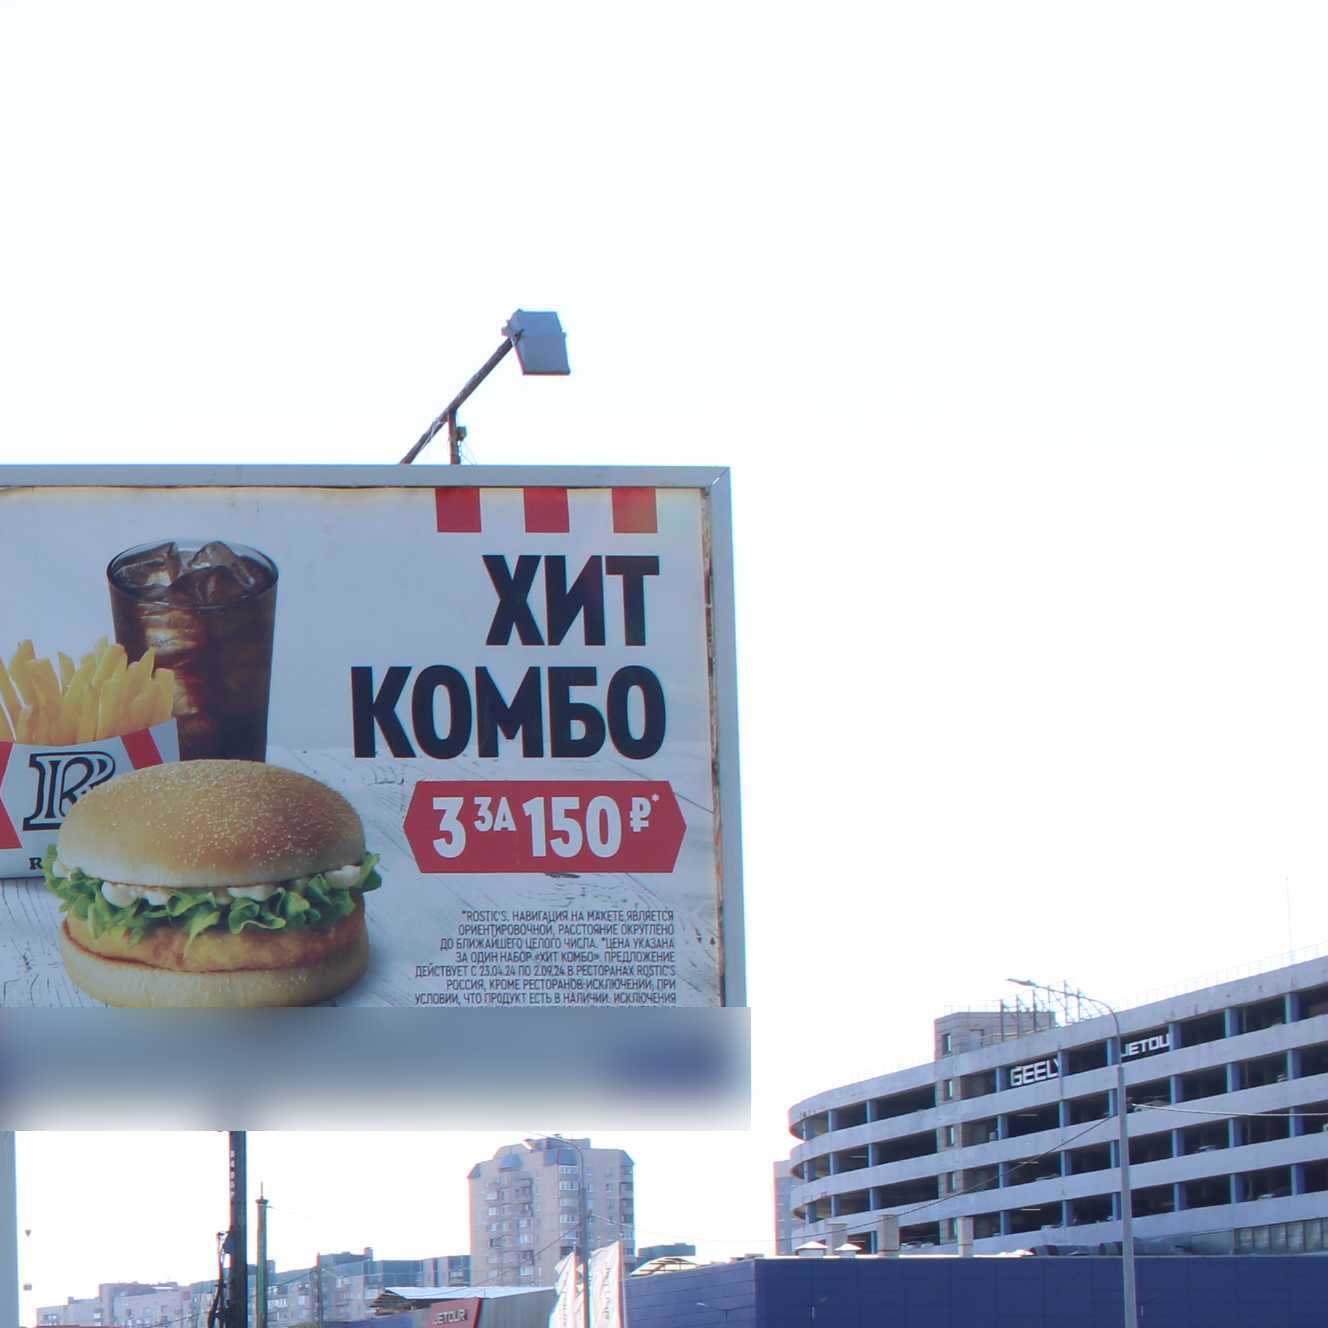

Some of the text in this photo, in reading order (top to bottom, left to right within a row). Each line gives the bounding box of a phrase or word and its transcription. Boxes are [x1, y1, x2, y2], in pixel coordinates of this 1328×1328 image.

[482, 555, 660, 646] ХИТ
[351, 665, 667, 760] КОМБО
[432, 796, 466, 858] 3
[474, 796, 517, 832] ЗА
[522, 795, 622, 858] 150
[512, 910, 568, 922] НАВИГАЦИЯ
[571, 910, 585, 921] НА
[587, 910, 623, 921] МАКЕТЕ
[626, 910, 674, 921] ЯВЛЯЕТСЯ
[558, 923, 618, 935] РАССТОЯНИЕ
[621, 923, 674, 935] ОКРУГЛЕНО
[440, 937, 454, 951] ДО
[456, 936, 522, 950] БЛИЖАЙШЕГО
[525, 937, 561, 950] ЦЕЛОГО
[633, 937, 675, 949] УКАЗАНА
[456, 951, 467, 963] ЗА
[470, 951, 498, 963] ОДИН
[500, 951, 532, 962] НАБОР
[604, 951, 675, 963] ПРЕДЛОЖЕНИЕ
[415, 962, 468, 977] ДЕЙСТВУЕТ
[470, 965, 476, 976] С
[479, 965, 515, 976] 23.04.24
[518, 965, 531, 976] ПО
[567, 965, 573, 976] В
[576, 965, 633, 976] РЕСТОРАНАХ
[446, 978, 486, 991] РОССИЯ,
[489, 978, 520, 990] КРОМЕ
[656, 978, 676, 990] ПРИ
[415, 992, 460, 1005] УСЛОВИИ,
[463, 992, 482, 1004] ЧТО
[484, 992, 526, 1005] ПРОДУКТ
[529, 992, 552, 1004] ЕСТЬ
[554, 992, 560, 1004] В
[613, 992, 676, 1004] ИСКЛЮЧЕНИЯ
